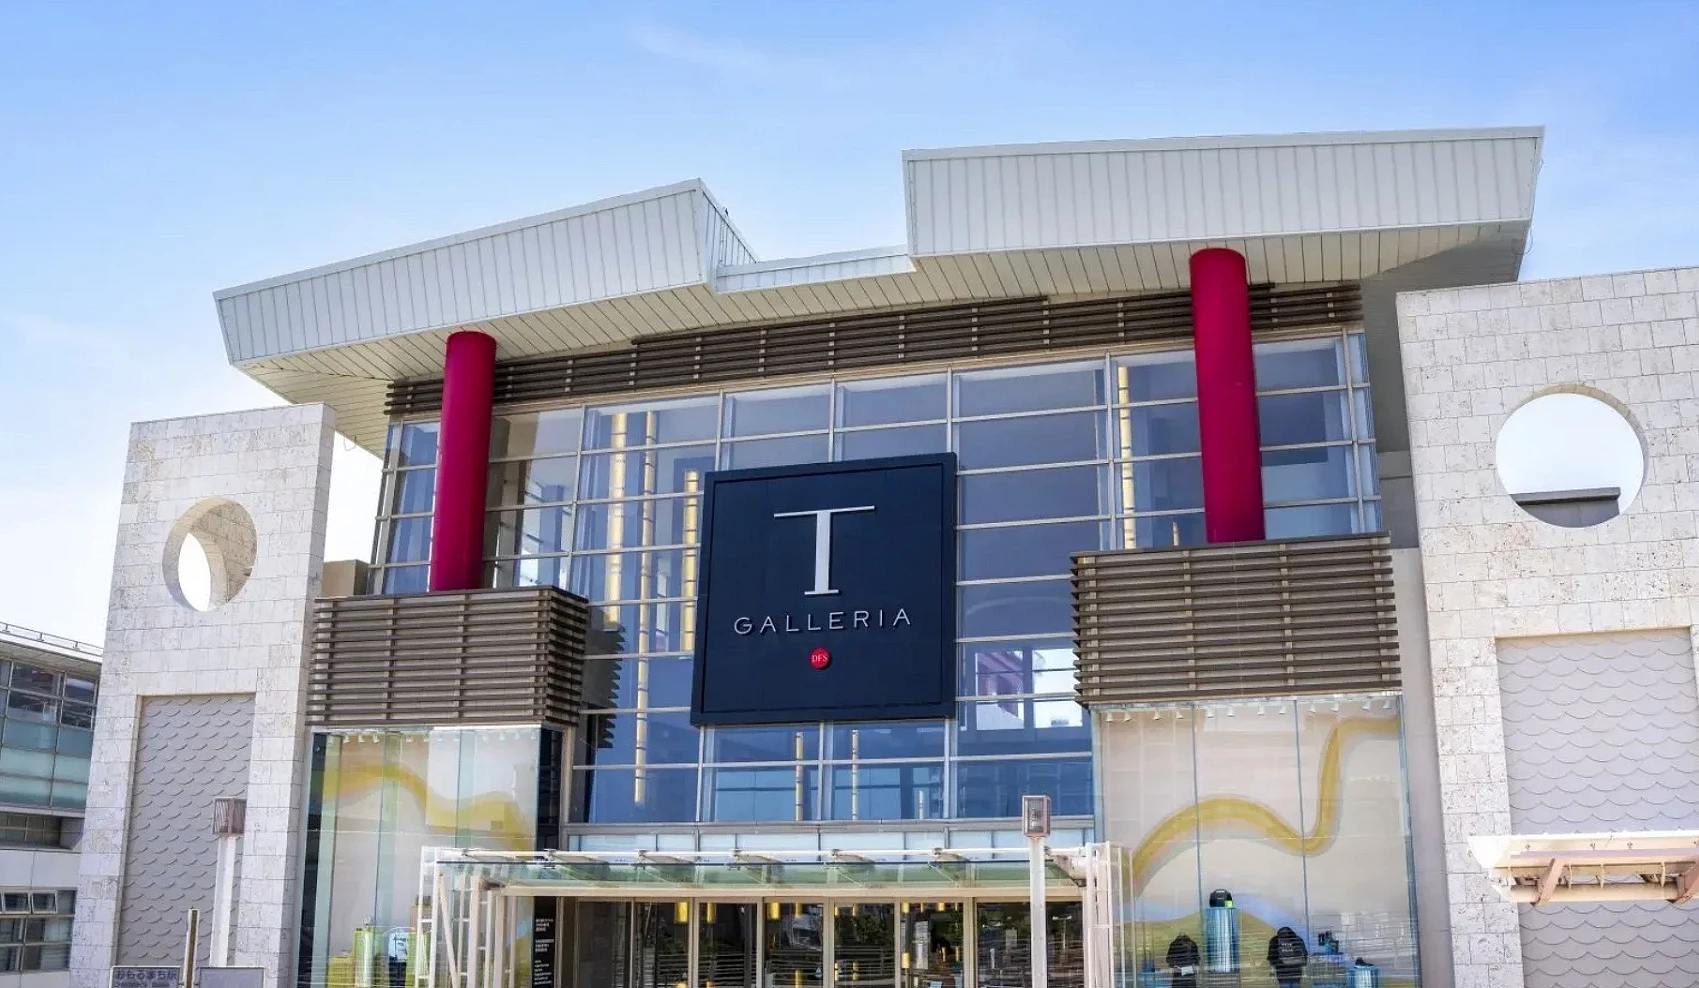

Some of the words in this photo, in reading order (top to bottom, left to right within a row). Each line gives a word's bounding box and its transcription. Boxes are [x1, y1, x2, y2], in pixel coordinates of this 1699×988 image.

[773, 505, 875, 595] T
[733, 608, 911, 635] GALLERIA
[811, 653, 828, 662] DFS
